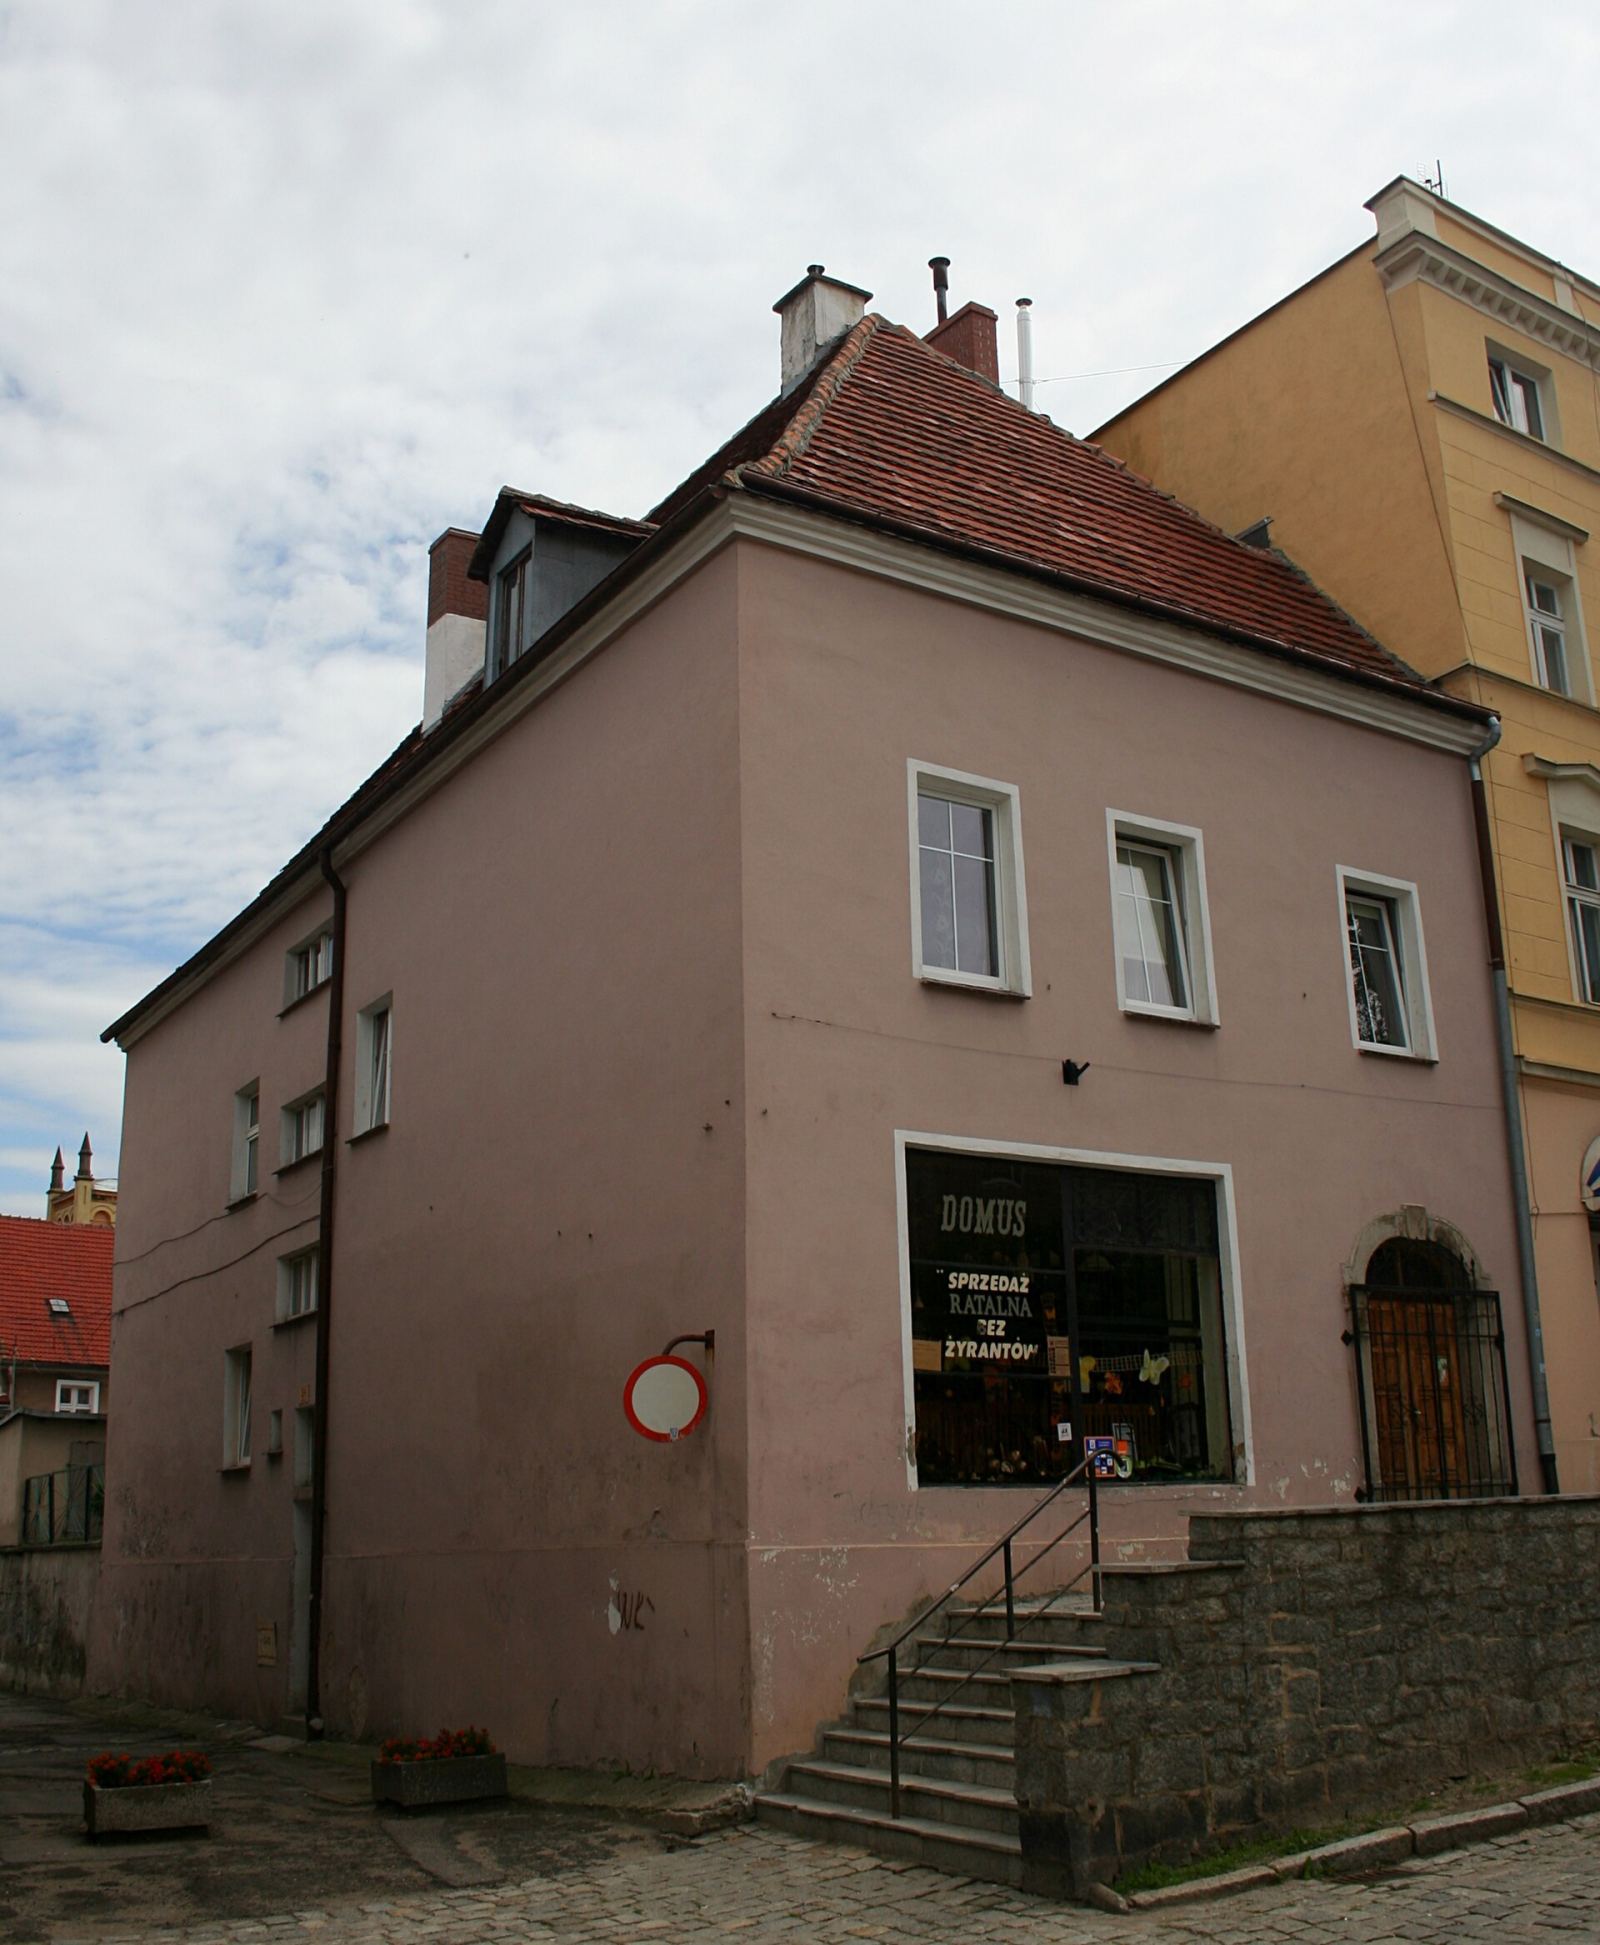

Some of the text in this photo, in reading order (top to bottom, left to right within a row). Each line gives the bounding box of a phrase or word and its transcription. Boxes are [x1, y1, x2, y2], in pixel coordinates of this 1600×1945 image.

[941, 1194, 1027, 1237] DOMUS
[948, 1272, 1030, 1293] SPRZEDAŻ
[949, 1293, 1033, 1318] RATALNA
[977, 1319, 1006, 1336] BEZ
